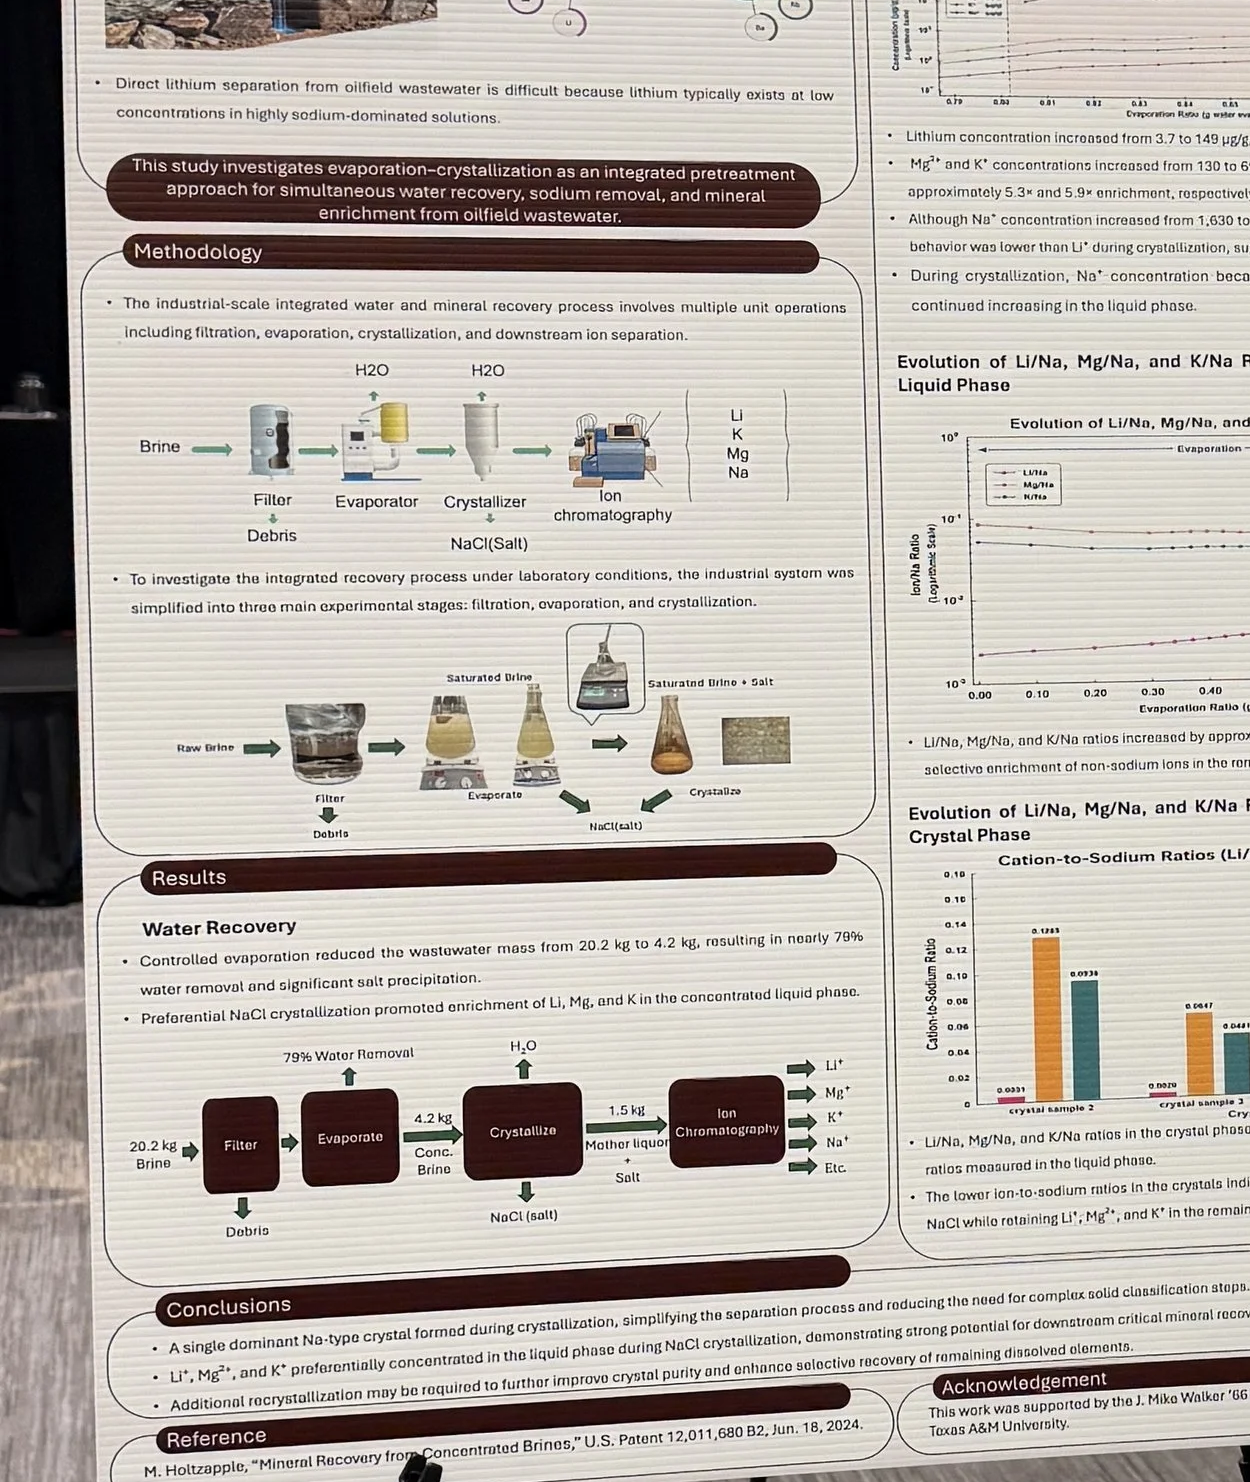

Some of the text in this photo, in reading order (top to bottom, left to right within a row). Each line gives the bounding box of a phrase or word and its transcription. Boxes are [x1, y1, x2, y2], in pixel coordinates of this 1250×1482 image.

[132, 158, 796, 183] This study investigates evaporation–crystallization as an integrated pretreatment
[134, 243, 263, 264] Methodology
[897, 354, 980, 369] Evolution
[989, 354, 1007, 369] of
[1016, 354, 1068, 371] Li/Na,
[1077, 354, 1139, 372] Mg/Na,
[1149, 354, 1181, 368] and
[1190, 354, 1233, 368] K/Na
[898, 377, 1010, 395] Liquid Phase
[140, 439, 181, 453] Brine
[335, 495, 419, 511] Evaporator
[444, 495, 527, 512] Crystallizer
[599, 489, 622, 502] Ion
[554, 508, 673, 524] chromatography
[247, 529, 297, 542] Debris
[909, 827, 1031, 847] Crystal Phase
[152, 869, 227, 886] Results
[142, 920, 297, 937] Water Recovery
[166, 1297, 291, 1319] Conclusions
[941, 1372, 1107, 1395] Acknowledgement
[167, 1430, 267, 1449] Reference
